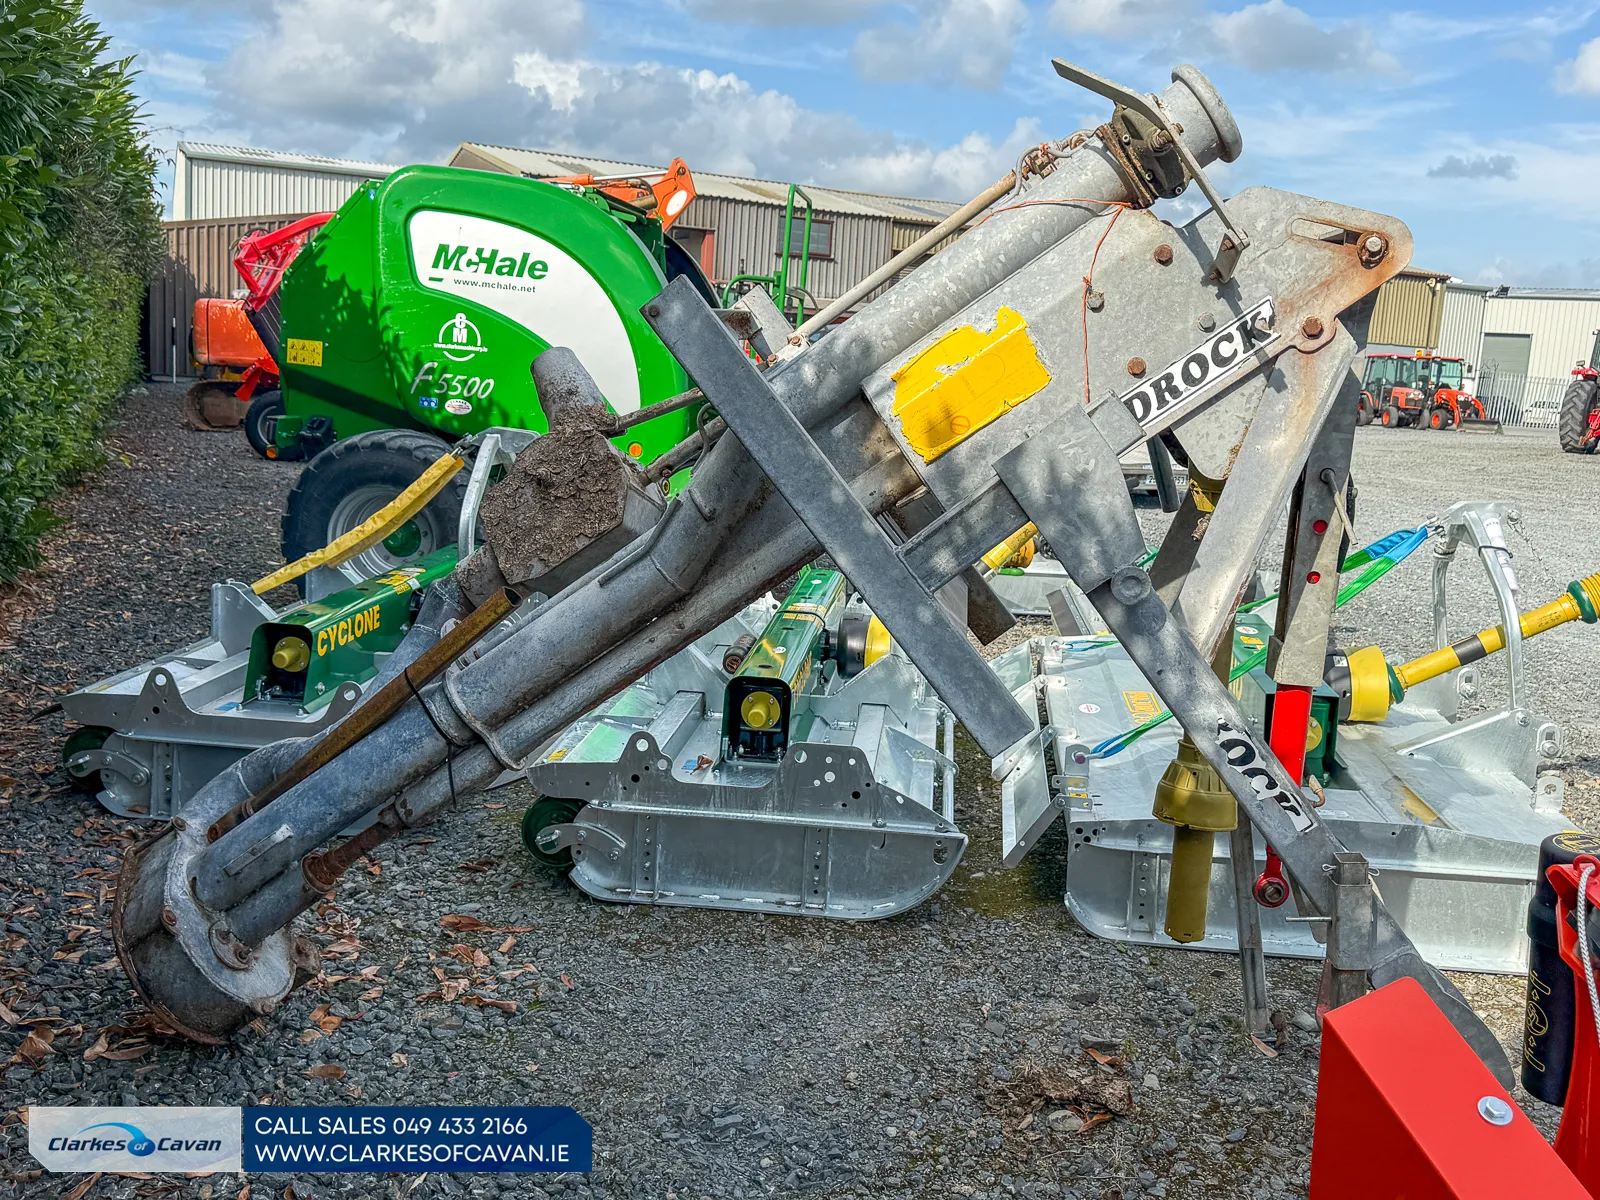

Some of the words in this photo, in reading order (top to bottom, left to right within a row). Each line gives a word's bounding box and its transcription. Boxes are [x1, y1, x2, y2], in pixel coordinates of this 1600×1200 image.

[431, 243, 549, 280] McHale
[453, 278, 536, 293] www.mchale.net
[317, 604, 380, 657] CYCLONE
